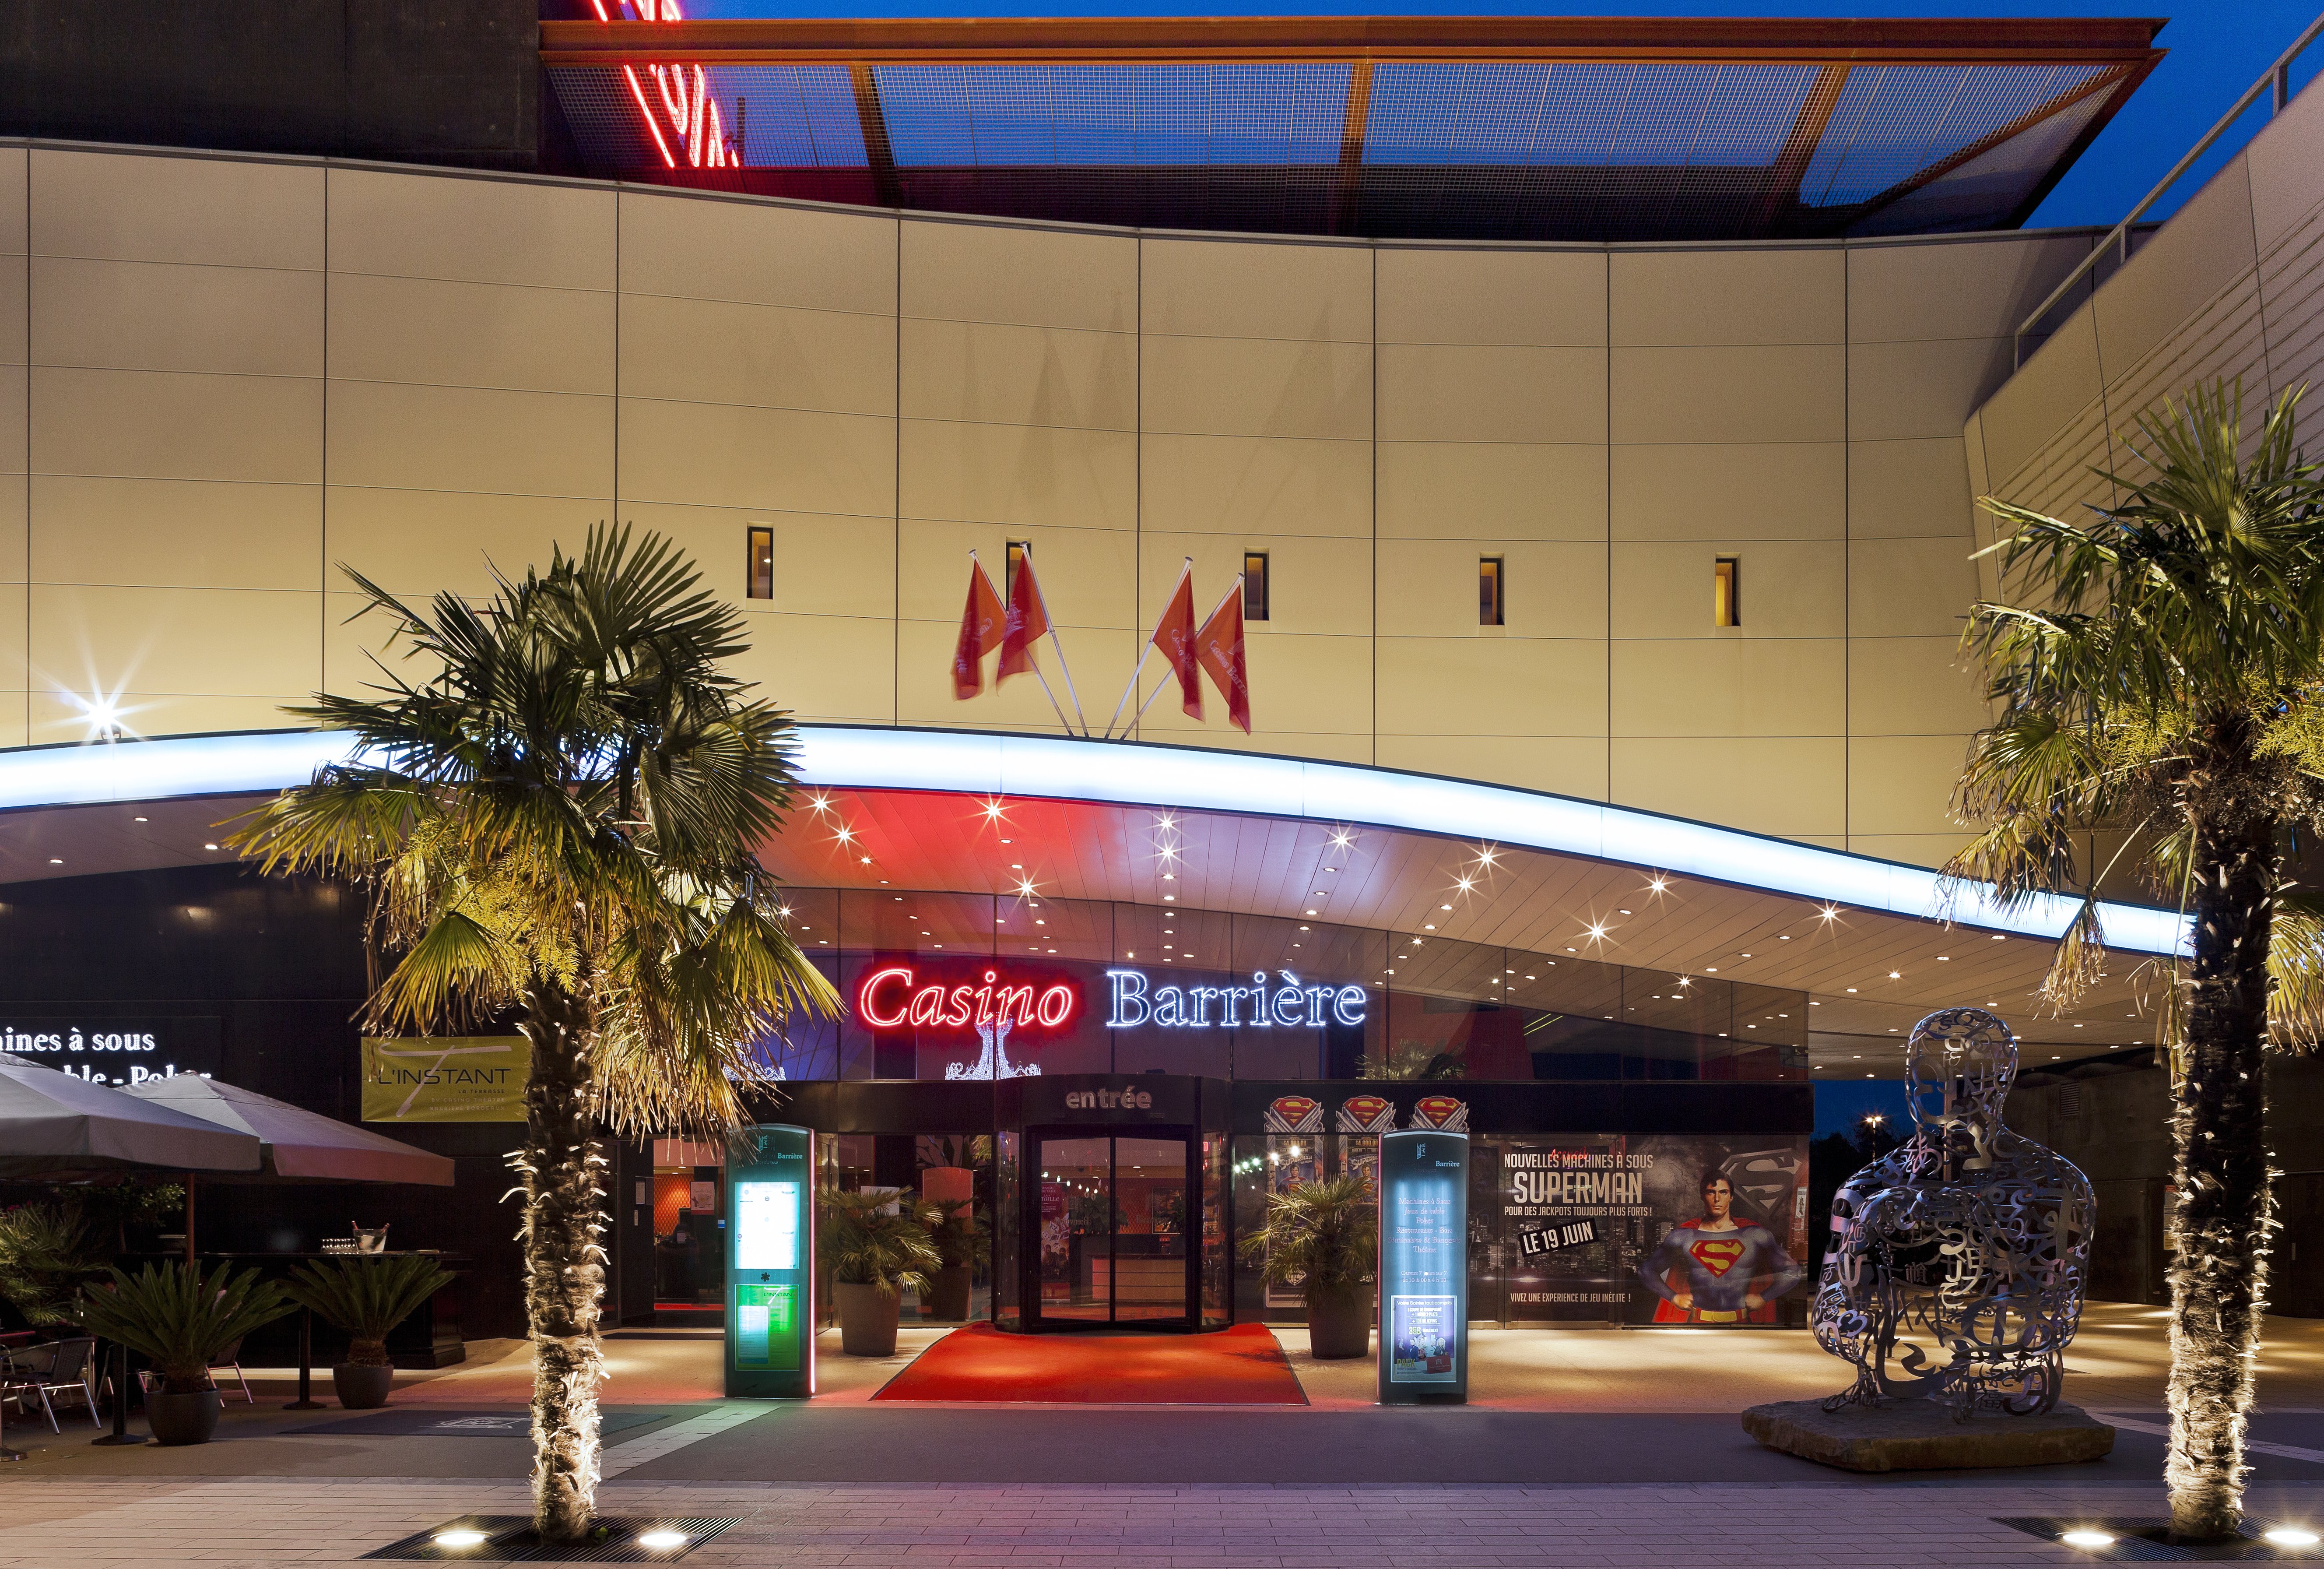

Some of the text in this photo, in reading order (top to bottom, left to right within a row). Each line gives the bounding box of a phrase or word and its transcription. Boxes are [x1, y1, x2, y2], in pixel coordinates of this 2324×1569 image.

[860, 968, 1366, 1027] Casino Barrière
[69, 1027, 84, 1051] à
[92, 1034, 155, 1051] sous
[378, 1068, 511, 1084] L'INSTANT
[1066, 1086, 1152, 1108] entrée
[1280, 1155, 1312, 1170] SUPERMAN
[1351, 1156, 1378, 1170] SUPERM
[1505, 1151, 1653, 1168] NOUVELLES MACHINES À SOUS
[1514, 1171, 1642, 1203] SUPERMAN
[1505, 1206, 1522, 1216] POUR
[1524, 1206, 1537, 1216] DES
[1538, 1206, 1571, 1216] JACKPOTS
[1573, 1207, 1608, 1216] TOUJOURS
[1609, 1207, 1625, 1216] PLUS
[1627, 1207, 1648, 1216] FORTS
[1432, 1237, 1460, 1245] Banquets
[1523, 1221, 1593, 1254] LE 19 JUIN
[1510, 1293, 1527, 1302] VIVEZ
[1528, 1293, 1540, 1302] UNE
[1542, 1293, 1578, 1302] EXPERIENCE
[1580, 1293, 1588, 1302] DE
[1590, 1293, 1600, 1302] JEU
[1397, 1358, 1415, 1368] PACK
